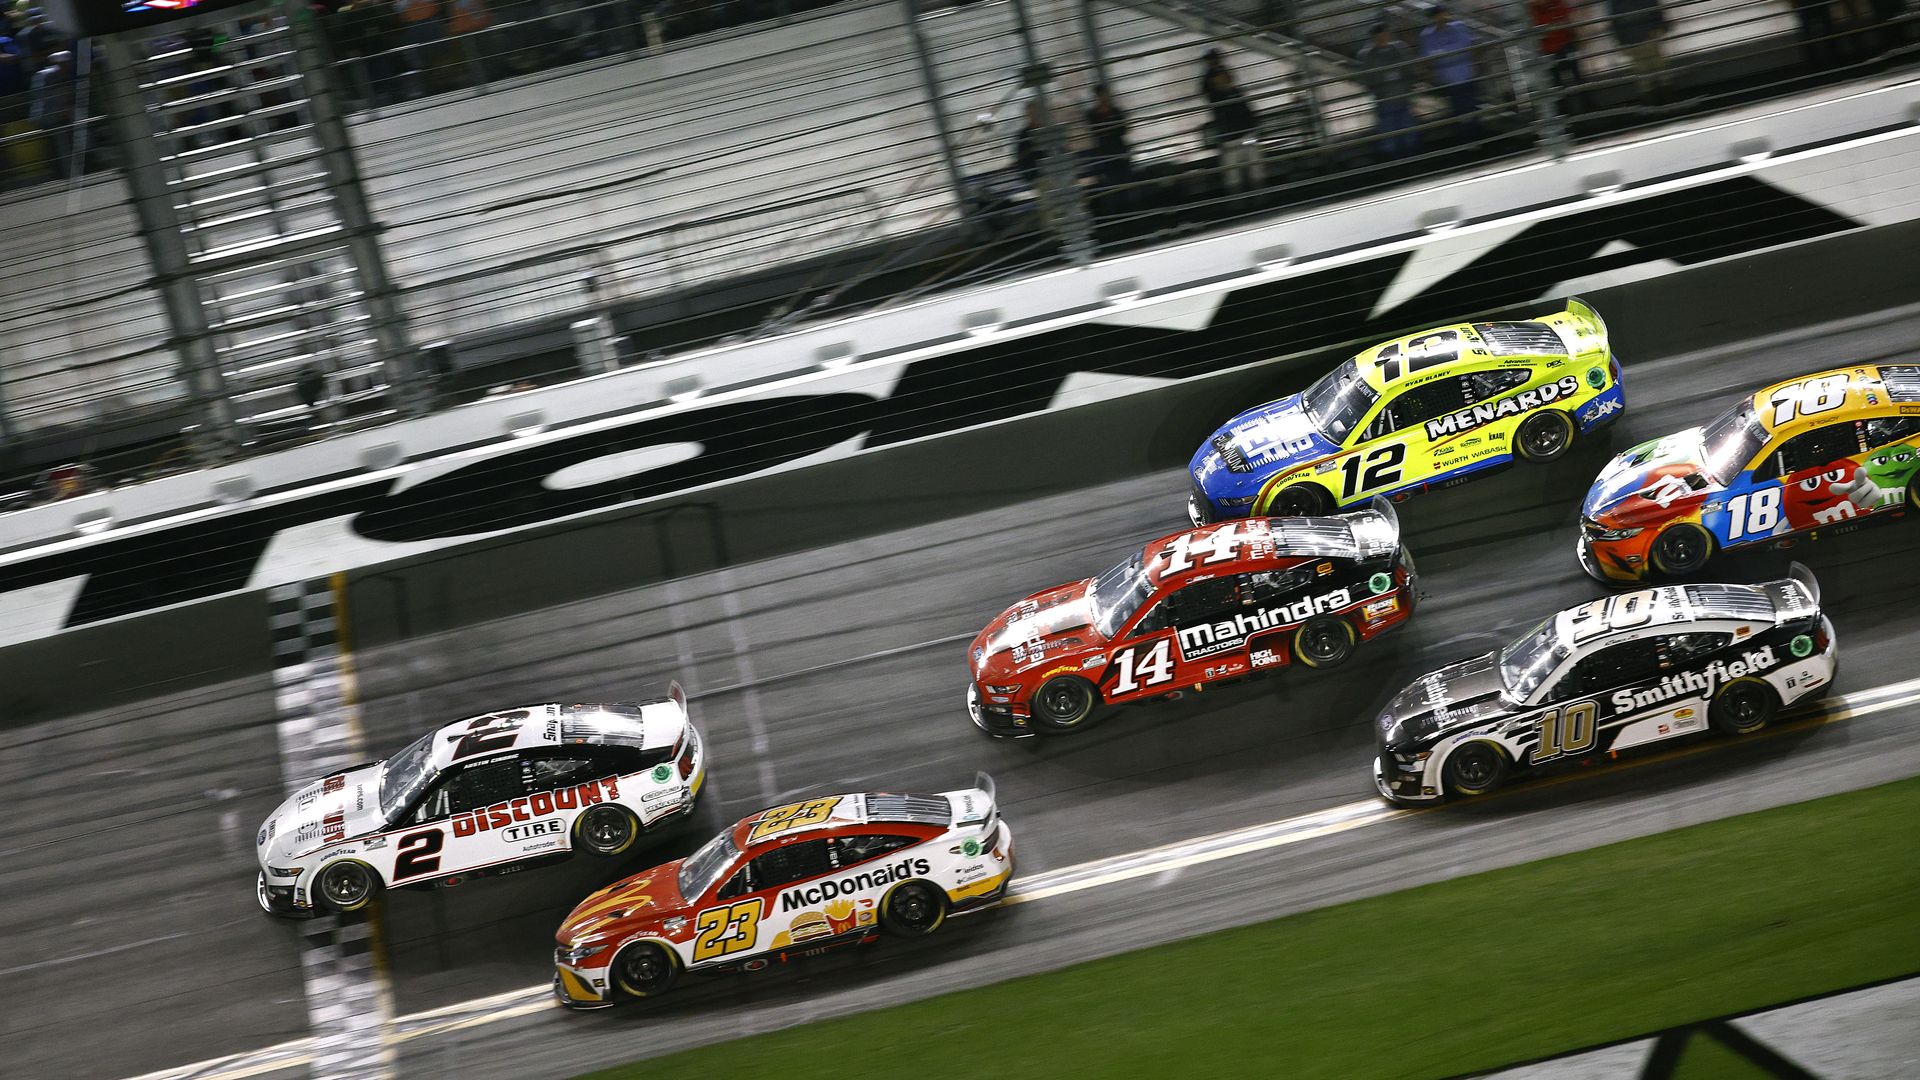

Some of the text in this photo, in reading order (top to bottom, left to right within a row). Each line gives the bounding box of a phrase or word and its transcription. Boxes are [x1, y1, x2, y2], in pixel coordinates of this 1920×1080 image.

[1376, 330, 1459, 383] 12
[1404, 370, 1451, 388] RYAN BLANEY
[1425, 375, 1579, 442] MENARDS
[1770, 373, 1850, 428] 18
[1341, 442, 1406, 499] 12
[1471, 446, 1507, 458] WABASH
[1276, 472, 1310, 488] GOODYEAR
[1727, 486, 1781, 540] 18
[1159, 524, 1239, 578] 14
[1573, 590, 1657, 644] 10
[1111, 639, 1174, 696] 14
[1186, 637, 1244, 659] TRACTORS
[1250, 648, 1273, 660] HIGH
[1251, 655, 1281, 667] POINT
[1611, 645, 1777, 714] Smithfield
[451, 709, 531, 762] 2
[1530, 701, 1598, 765] 10
[450, 774, 620, 838] DISCOUNT
[507, 820, 561, 840] TIRE
[749, 796, 843, 841] 23
[393, 828, 445, 883] 2
[782, 857, 930, 912] McDonald's
[692, 898, 763, 964] 23
